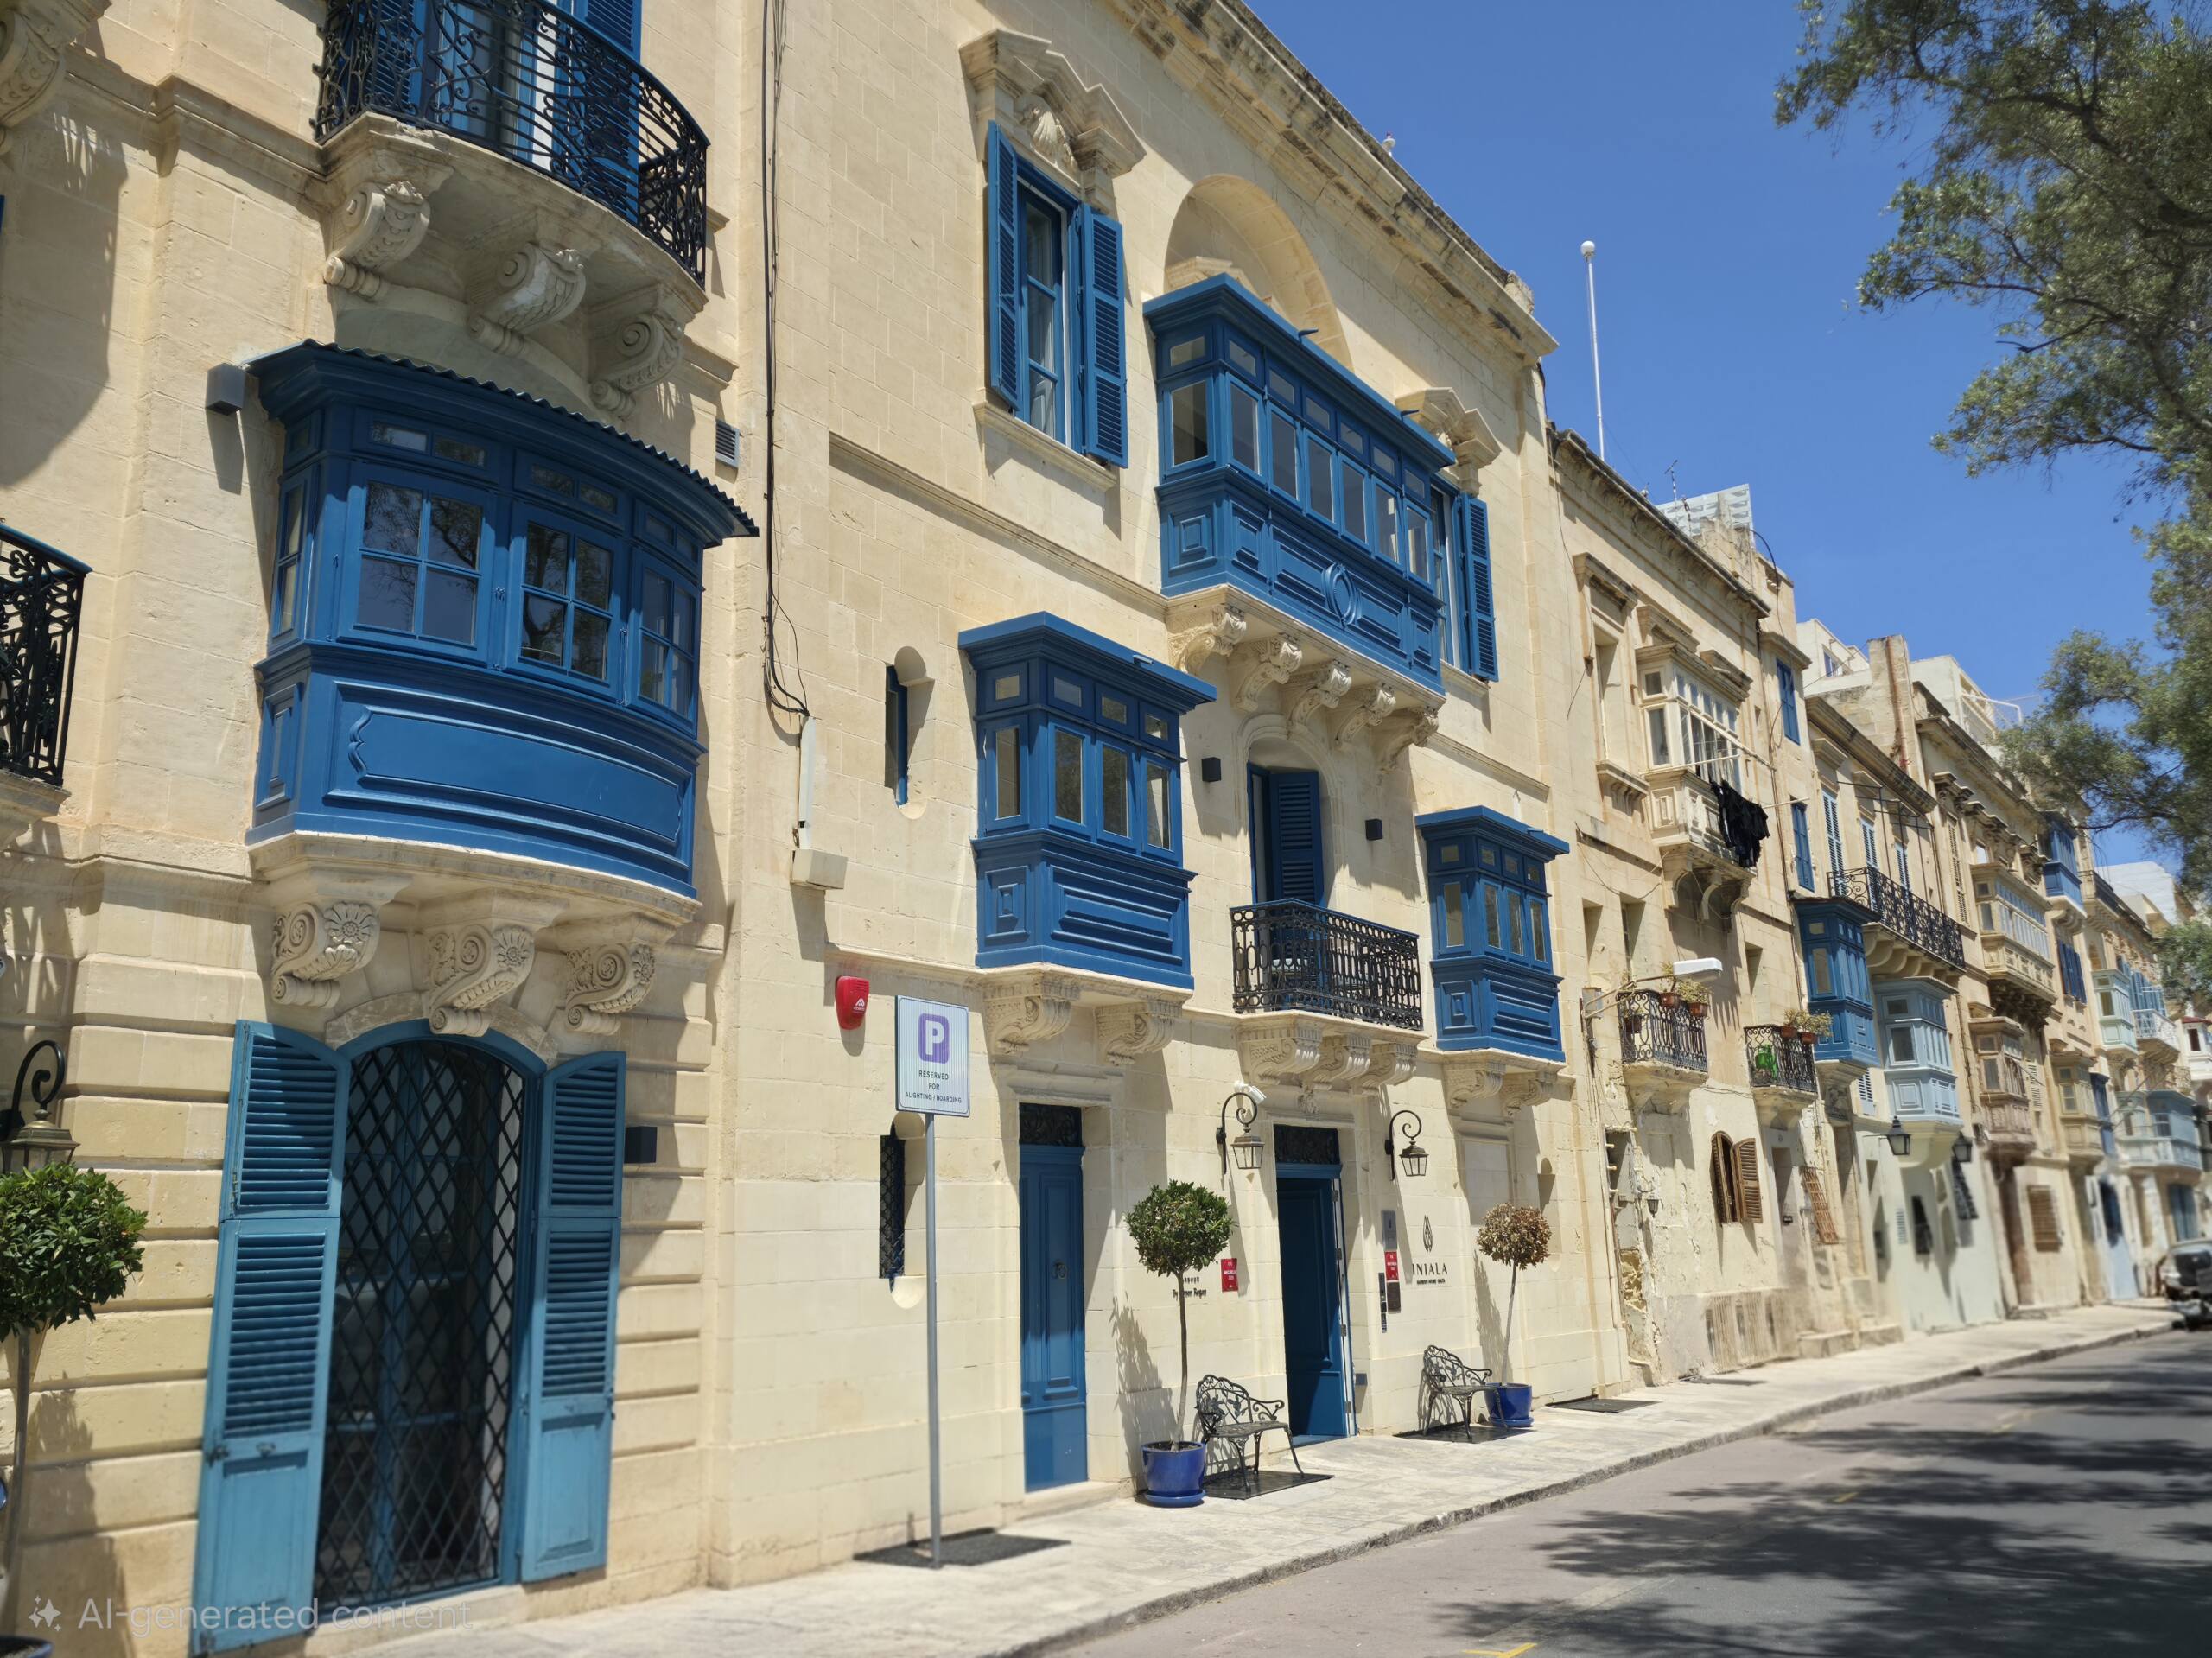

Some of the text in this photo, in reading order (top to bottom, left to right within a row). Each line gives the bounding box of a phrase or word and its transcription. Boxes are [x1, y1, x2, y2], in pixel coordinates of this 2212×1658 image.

[925, 1020, 944, 1055] P
[918, 1070, 949, 1080] RESERVED
[905, 1091, 932, 1100] ALIGHTING
[936, 1095, 962, 1103] BOARDING
[1412, 1262, 1447, 1276] INIALA
